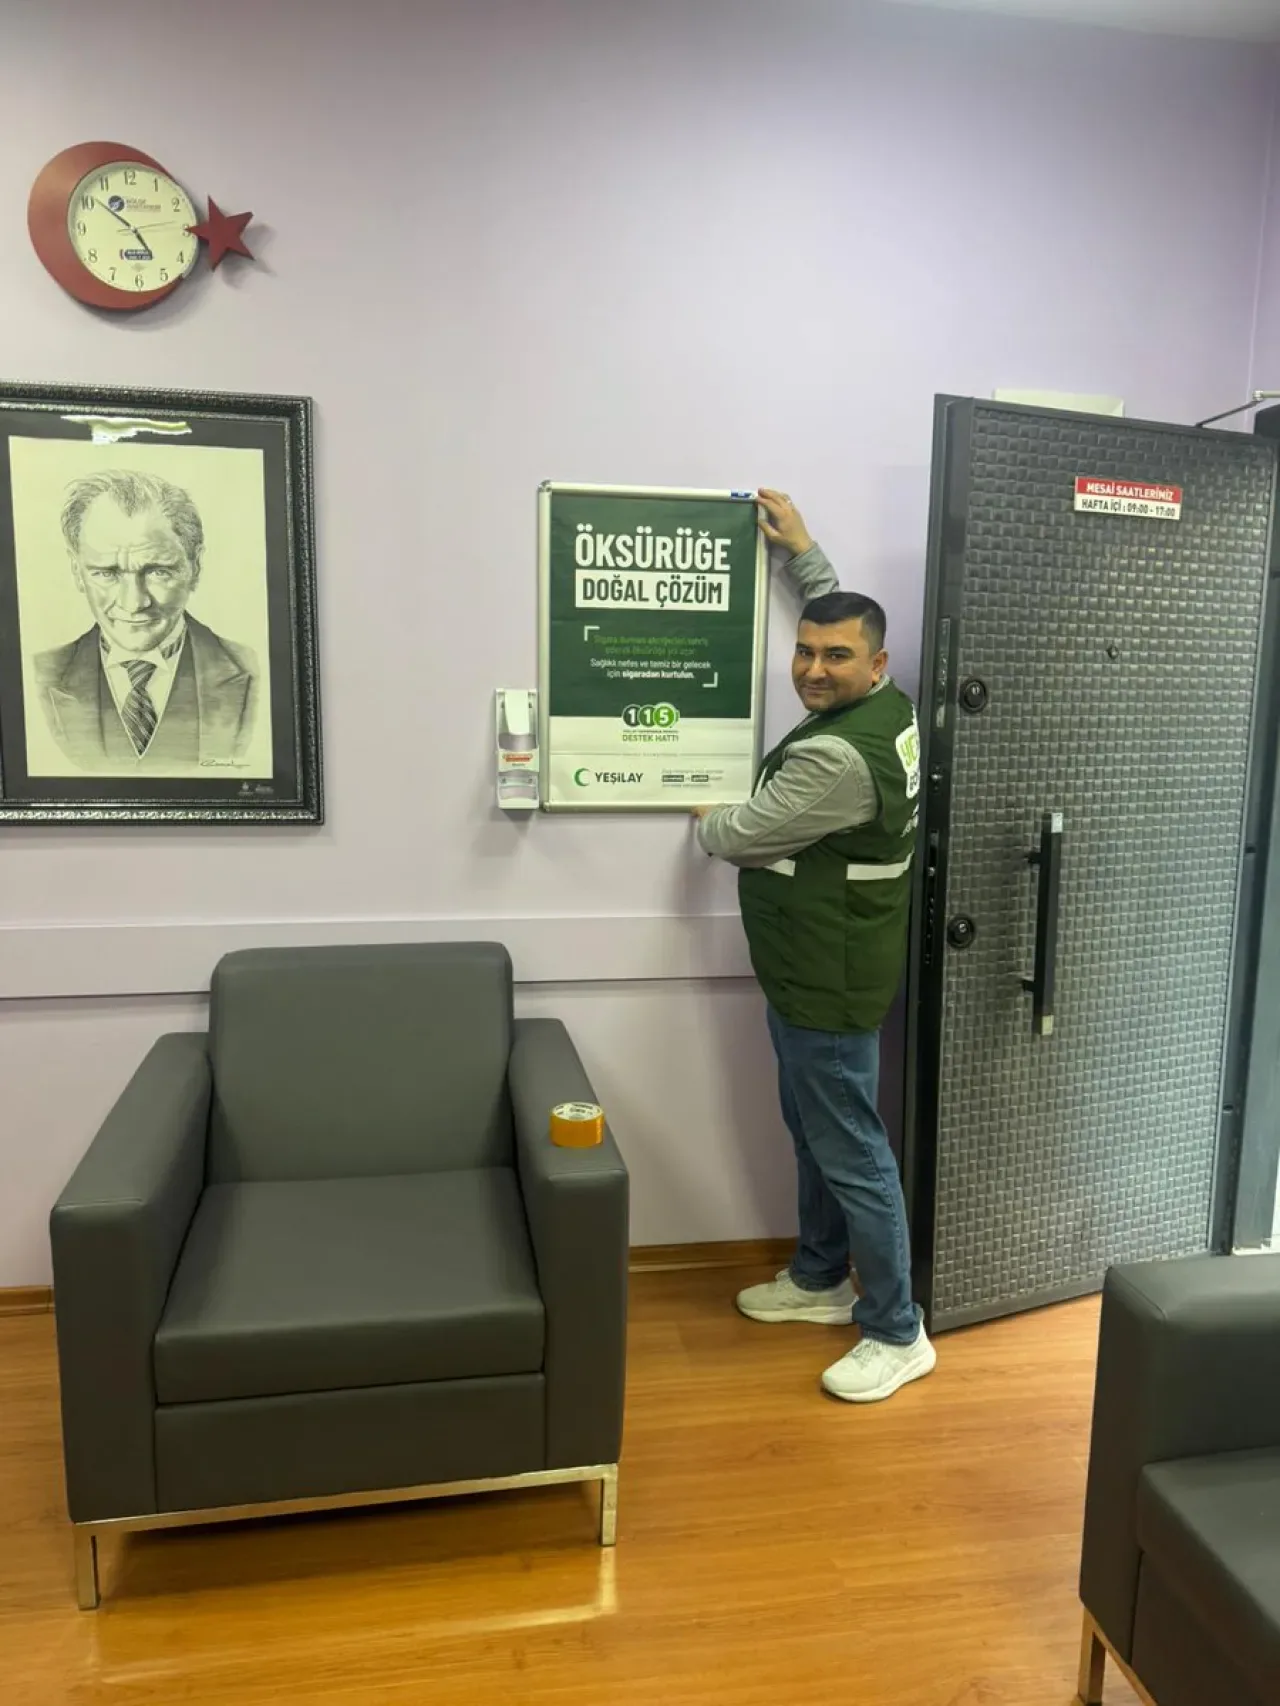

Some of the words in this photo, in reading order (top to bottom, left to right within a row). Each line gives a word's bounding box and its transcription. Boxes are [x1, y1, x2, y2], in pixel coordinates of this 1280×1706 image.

[100, 176, 109, 192] 11
[124, 171, 137, 185] 12
[154, 178, 159, 192] 1
[81, 195, 95, 210] 10
[171, 198, 181, 213] 2
[77, 222, 87, 236] 9
[182, 223, 191, 238] 3
[88, 249, 98, 263] 8
[176, 251, 185, 264] 4
[108, 267, 117, 281] 7
[160, 268, 169, 282] 5
[134, 275, 144, 289] 6
[1086, 482, 1115, 494] MESAİ
[1115, 485, 1175, 501] SAATLERİMİZ
[1081, 498, 1109, 511] HAFTA
[1110, 498, 1122, 512] İÇİ
[1127, 503, 1149, 514] 09:00
[1155, 505, 1176, 517] 17:00
[575, 523, 732, 572] ÖKSÜRÜĞE
[582, 575, 650, 602] DOĞAL
[656, 575, 723, 608] ÇÖZÜM
[617, 659, 639, 669] nefes
[639, 661, 649, 669] ve
[649, 660, 671, 669] temiz
[671, 660, 682, 669] bir
[683, 661, 712, 671] gelecek
[606, 669, 621, 680] için
[622, 670, 661, 680] sigaradan
[628, 707, 670, 725] 115
[622, 734, 654, 742] DESTEK
[655, 734, 679, 742] HATTI
